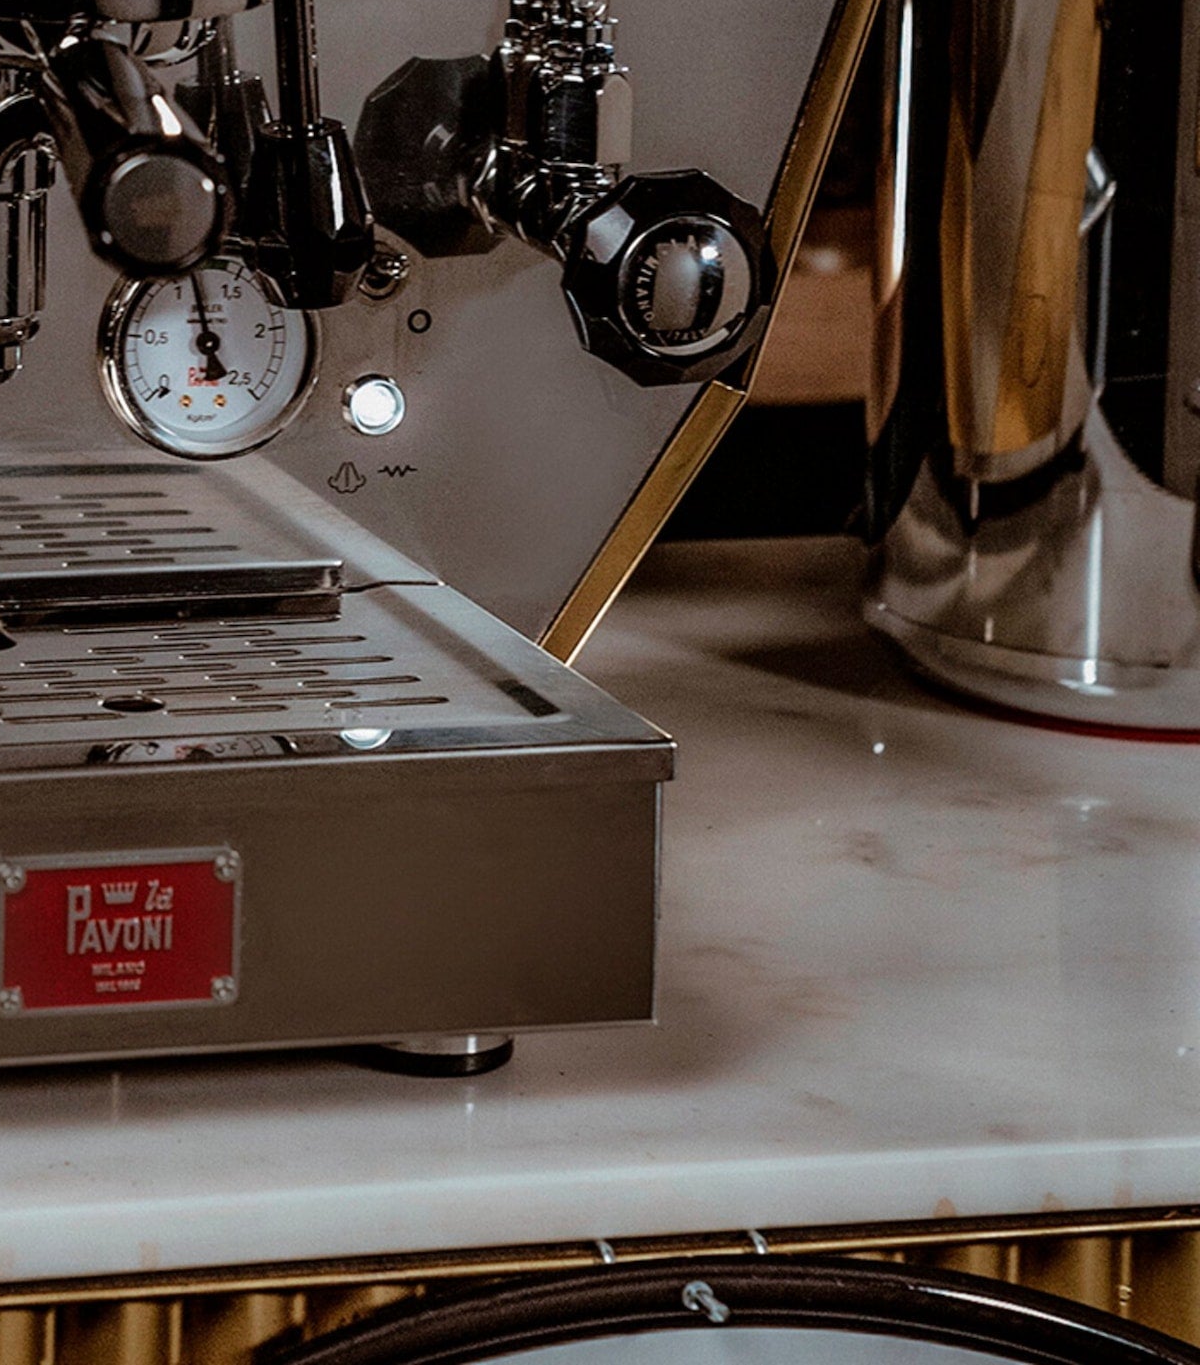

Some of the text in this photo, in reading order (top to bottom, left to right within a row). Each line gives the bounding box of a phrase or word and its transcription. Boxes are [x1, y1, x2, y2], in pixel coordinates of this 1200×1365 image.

[174, 286, 182, 300] 1
[220, 284, 242, 301] 1,5
[144, 329, 169, 345] 0,5
[255, 324, 266, 339] 2
[227, 369, 252, 386] 2,5
